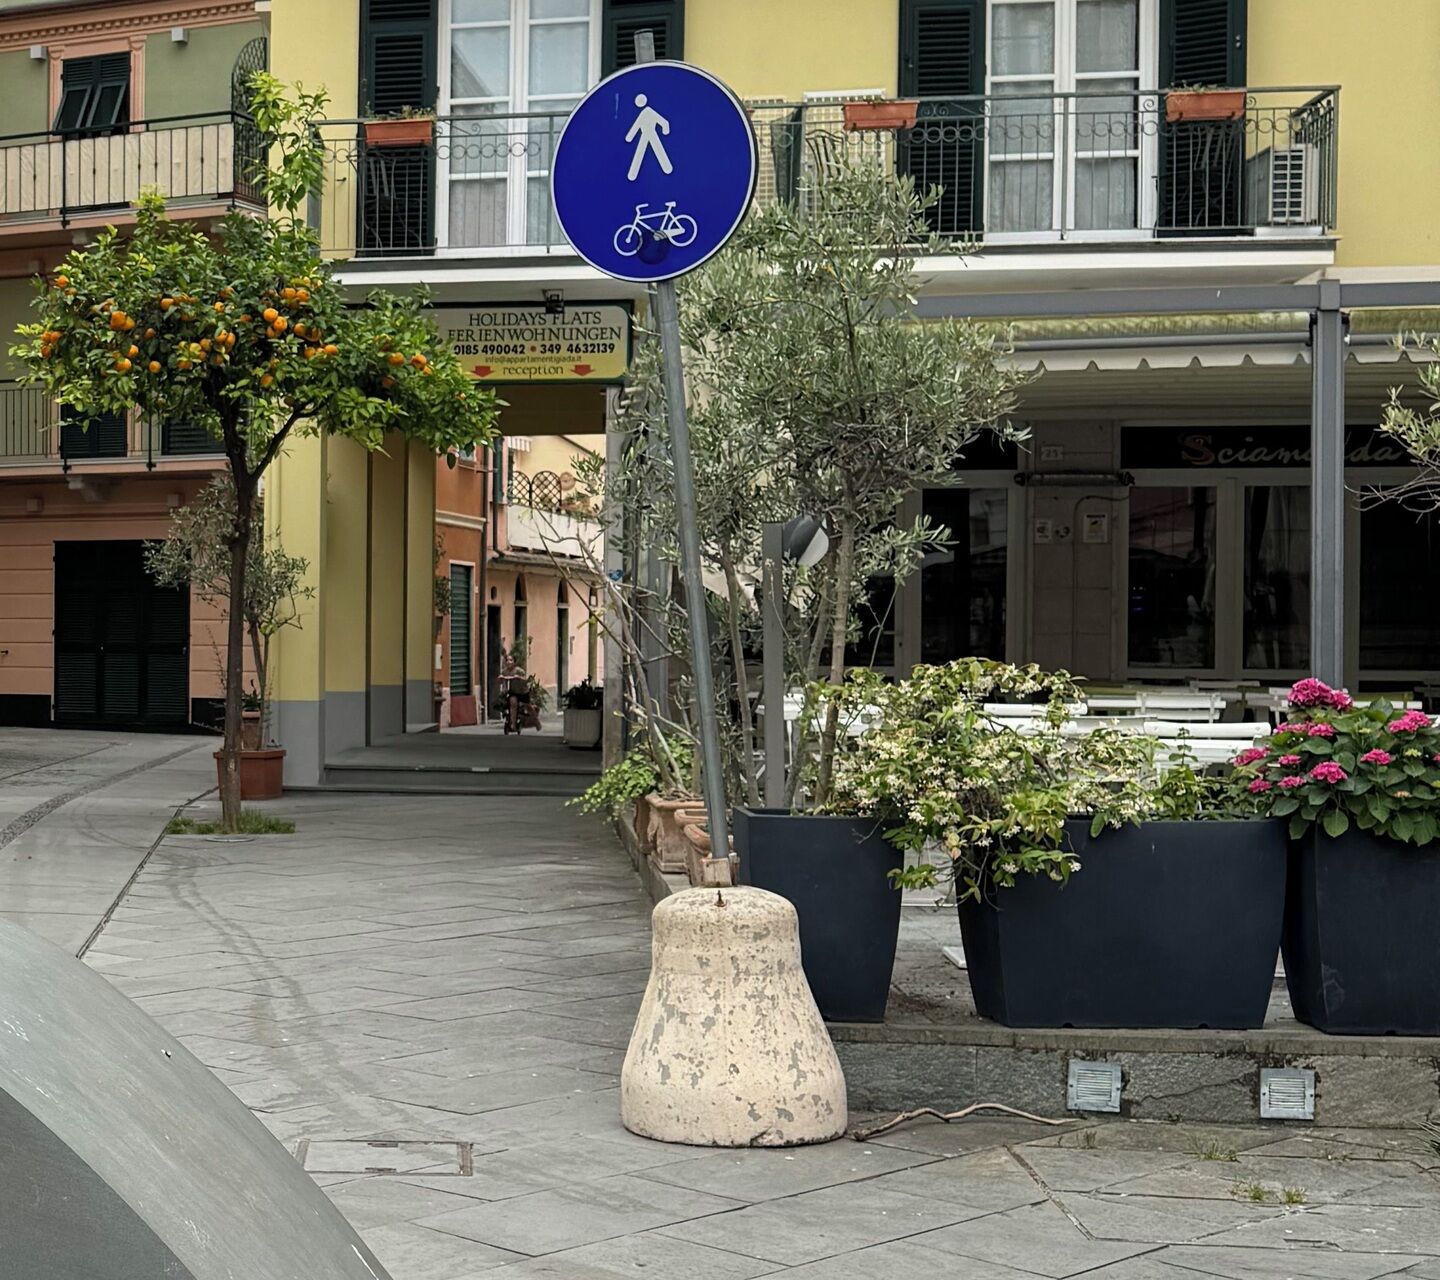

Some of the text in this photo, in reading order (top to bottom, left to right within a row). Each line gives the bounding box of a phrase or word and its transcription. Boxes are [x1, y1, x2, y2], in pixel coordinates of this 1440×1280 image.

[469, 311, 601, 326] HOLIDAYS FLATS
[449, 326, 622, 342] FERIENWOHNUNGEN
[454, 342, 615, 355] 0185 490042 349 4632139
[503, 365, 564, 379] reception
